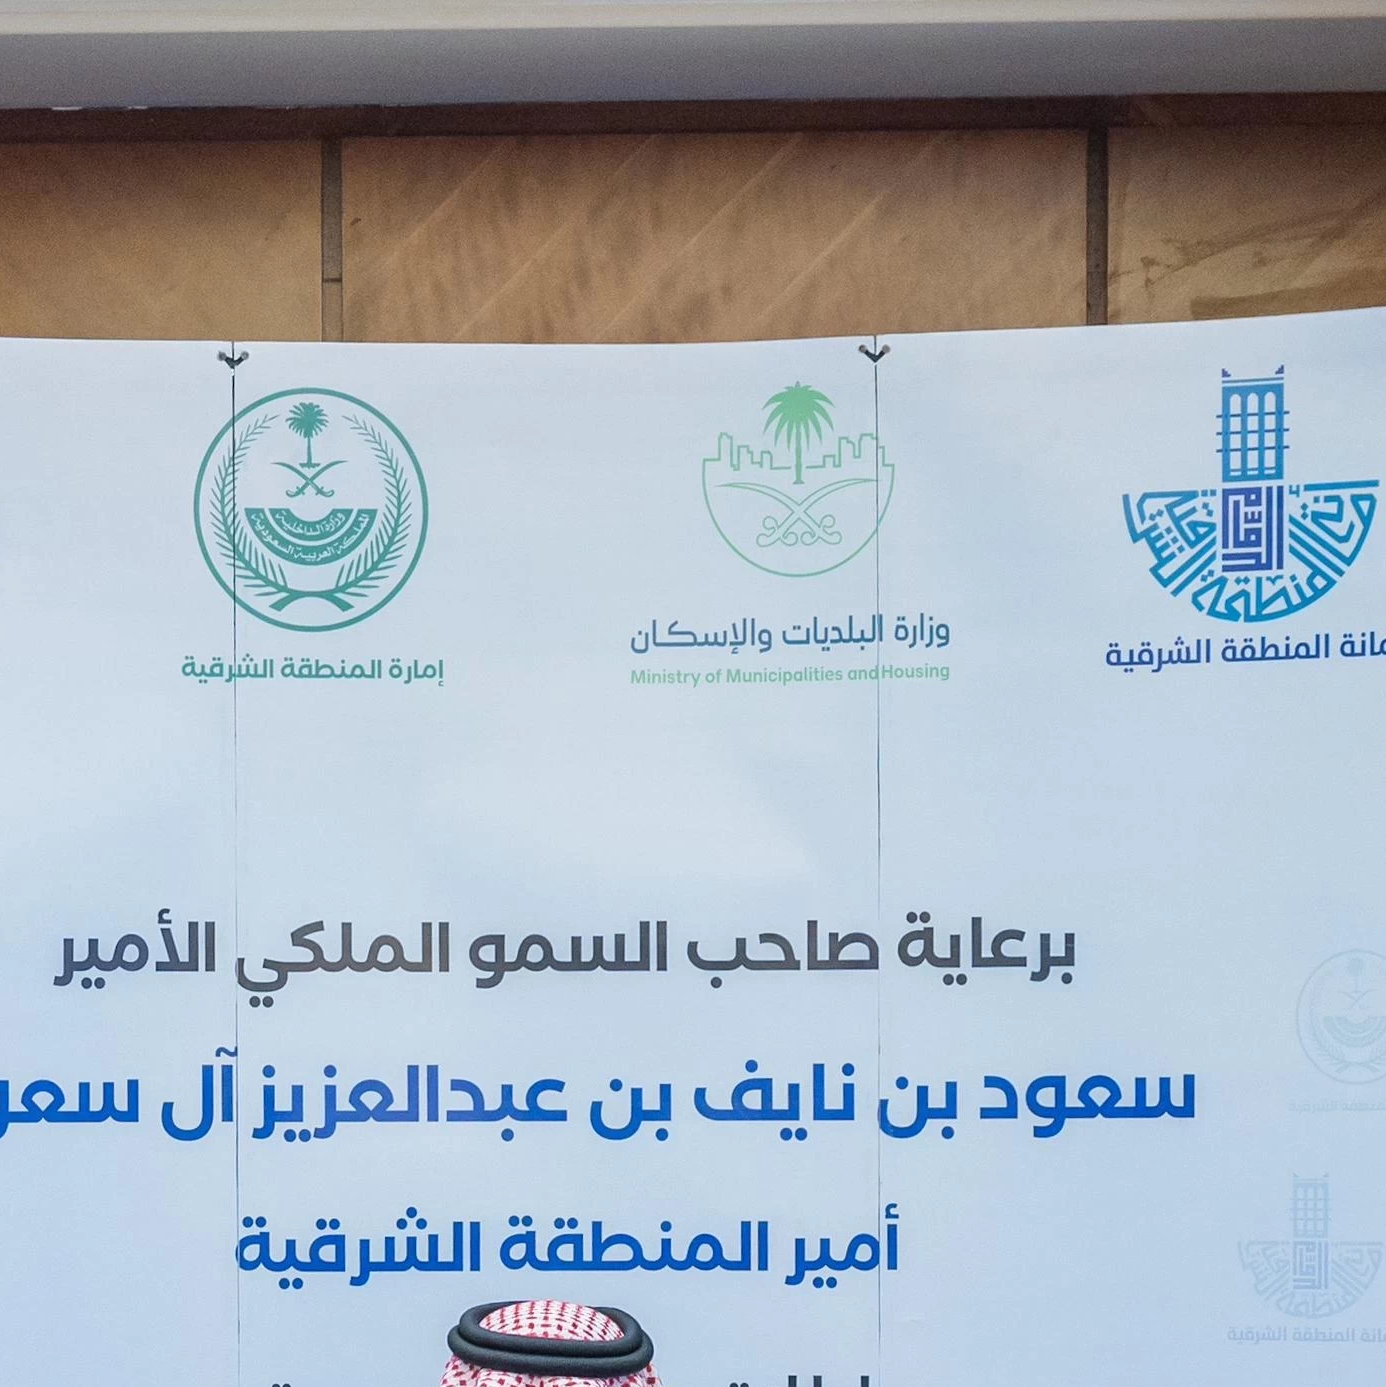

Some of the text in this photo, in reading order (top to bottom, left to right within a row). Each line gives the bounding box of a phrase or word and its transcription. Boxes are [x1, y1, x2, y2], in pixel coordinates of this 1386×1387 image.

[630, 612, 950, 654] وزارة البلديات والإسكان
[1105, 636, 1211, 673] الشرقية
[1220, 633, 1330, 663] المنطقة
[181, 653, 444, 687] إمارة المنطقة الشرقية
[630, 663, 950, 688] Ministry of Municipalities and Housing
[53, 908, 1075, 1008] برعاية صاحب السمو الملكي الأمير
[162, 1045, 238, 1142] آل
[252, 1064, 567, 1143] عبدالعزيز
[589, 1078, 672, 1142] بن
[693, 1059, 855, 1142] نايف
[878, 1077, 957, 1140] بن
[979, 1073, 1195, 1138] سعود
[235, 1202, 899, 1289] أمير المنطقة الشرقية
[1227, 1324, 1287, 1345] الشرقية
[1292, 1326, 1355, 1343] المنطقة
